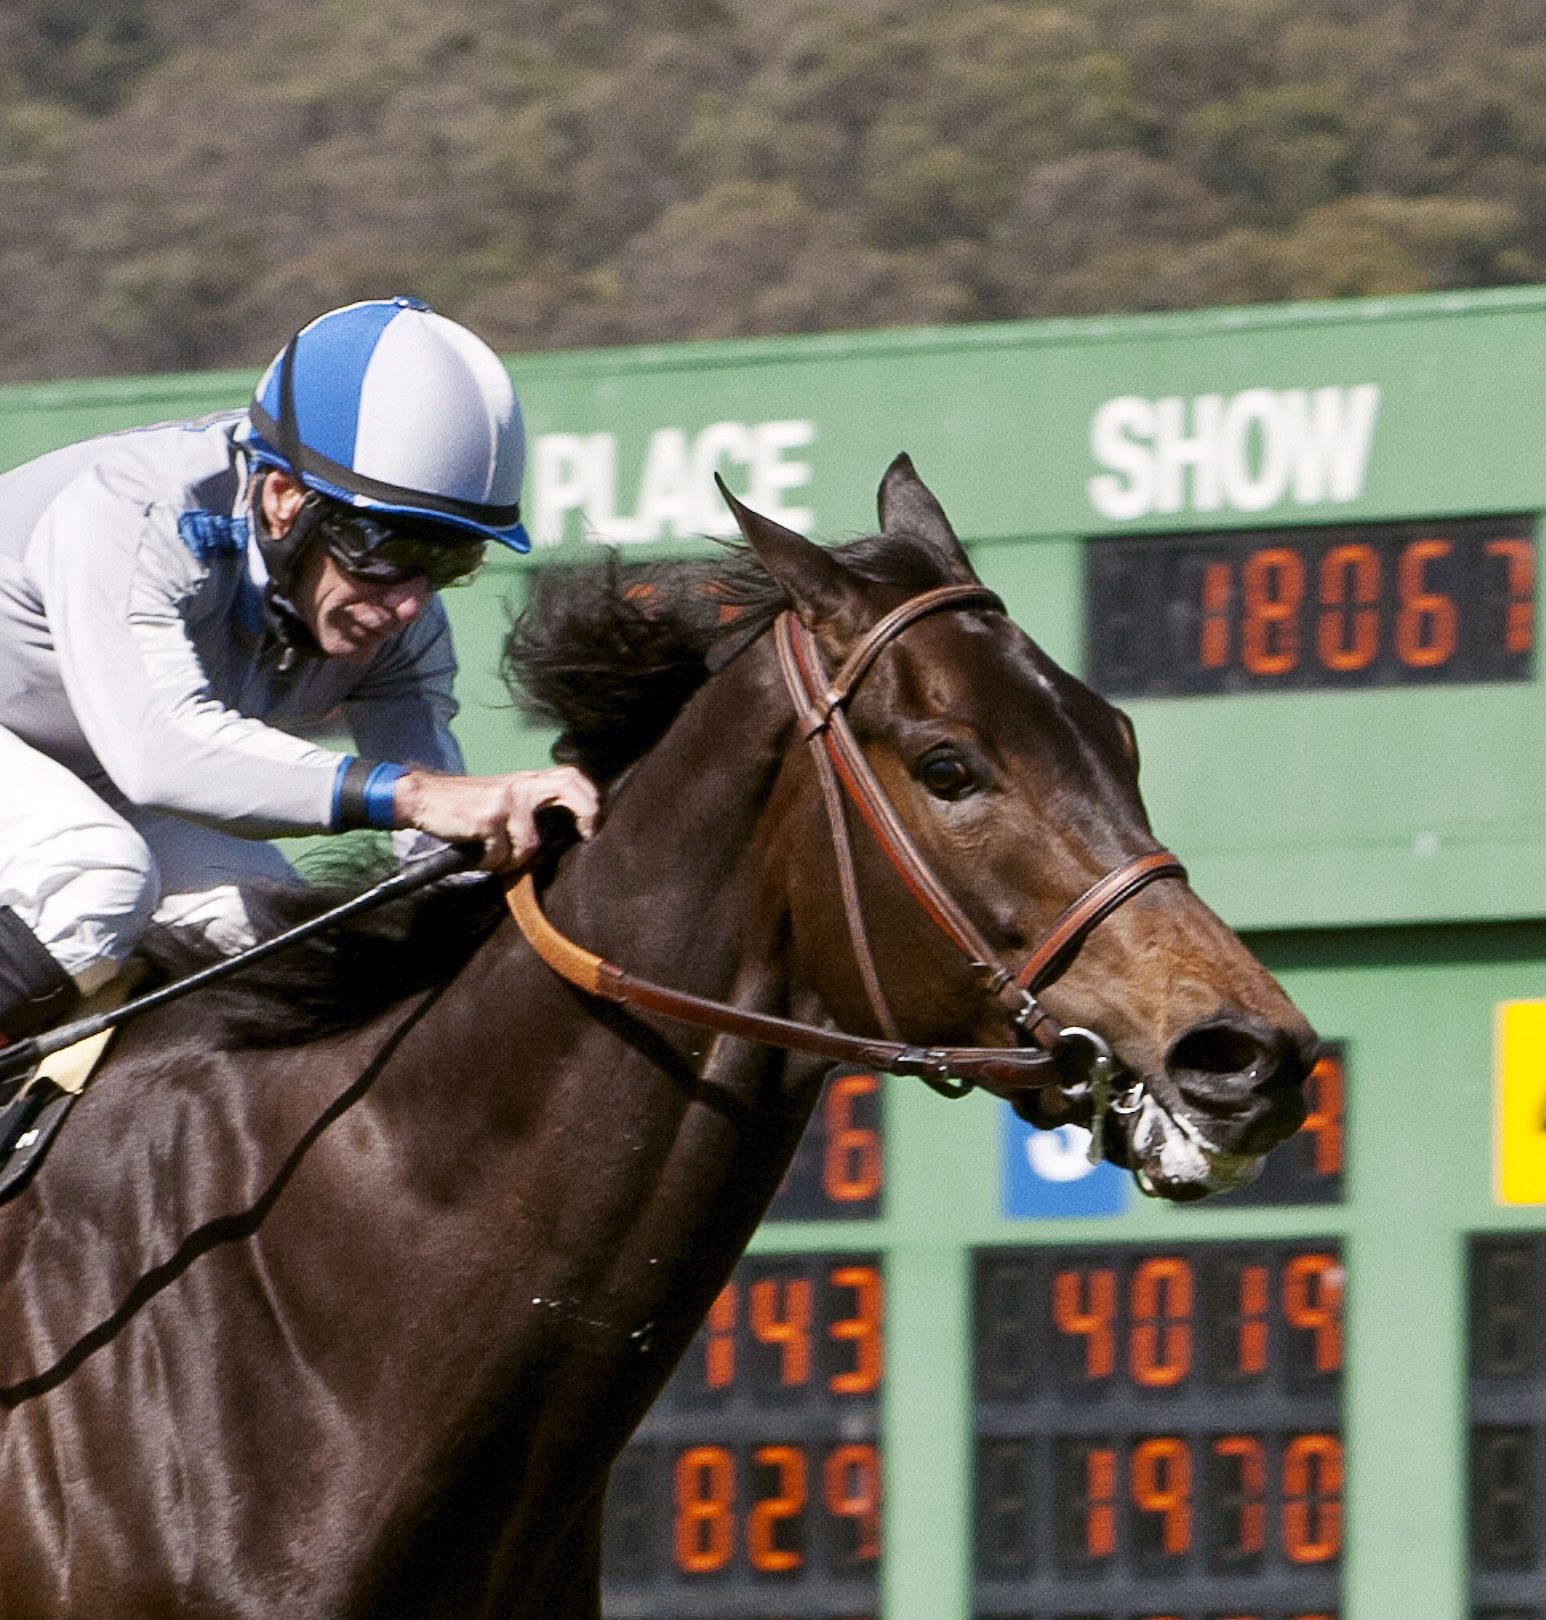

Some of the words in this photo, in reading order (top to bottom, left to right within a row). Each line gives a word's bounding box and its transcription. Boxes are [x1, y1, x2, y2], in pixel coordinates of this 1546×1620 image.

[532, 419, 815, 550] PLACE
[1088, 385, 1380, 520] SHOW
[1200, 539, 1536, 676] 18067
[1052, 1253, 1344, 1386] 4019
[672, 1444, 884, 1572] 829
[1085, 1433, 1345, 1563] 1970
